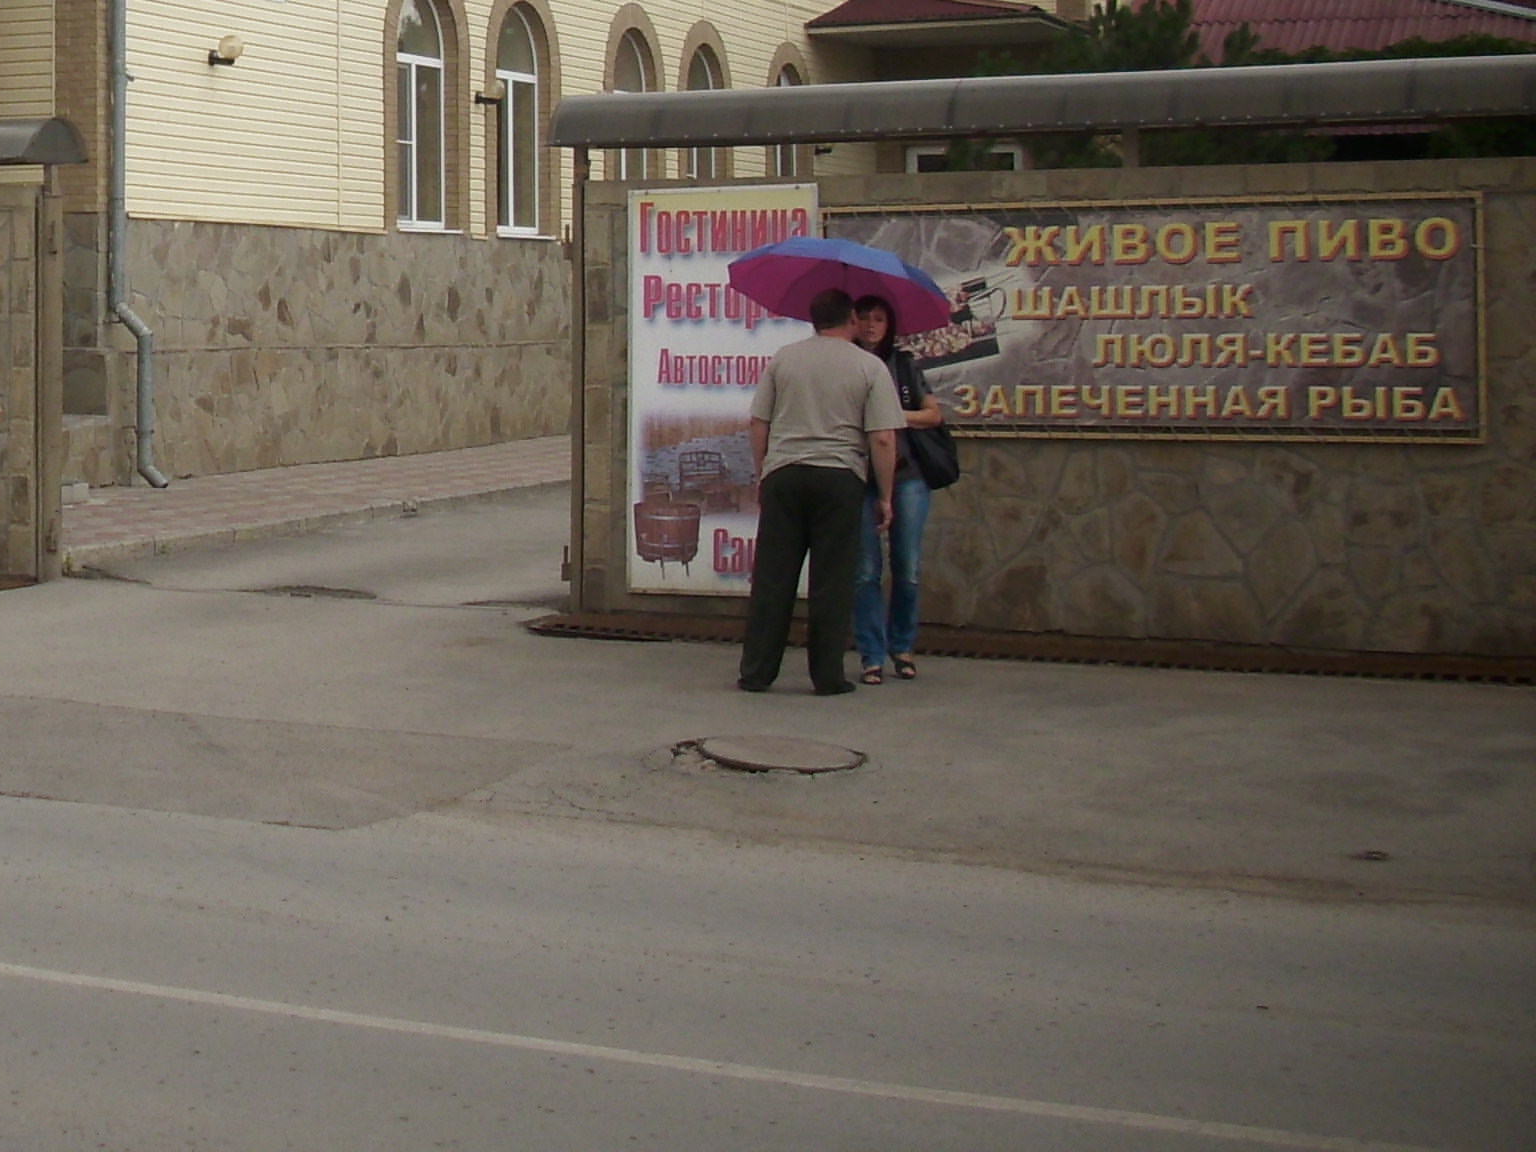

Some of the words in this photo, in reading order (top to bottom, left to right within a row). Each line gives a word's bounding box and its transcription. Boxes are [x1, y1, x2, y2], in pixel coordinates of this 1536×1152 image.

[1002, 222, 1242, 266] ЖИВОЕ
[1268, 217, 1461, 262] ПИВО
[643, 275, 785, 330] Рестор
[1012, 283, 1254, 320] ШАШЛЫК
[657, 348, 772, 385] Автостоя
[1092, 332, 1441, 369] ЛЮЛЯ-КЕБАБ
[953, 384, 1291, 420] ЗАПЕЧЕННАЯ
[1306, 385, 1466, 422] РЫБА
